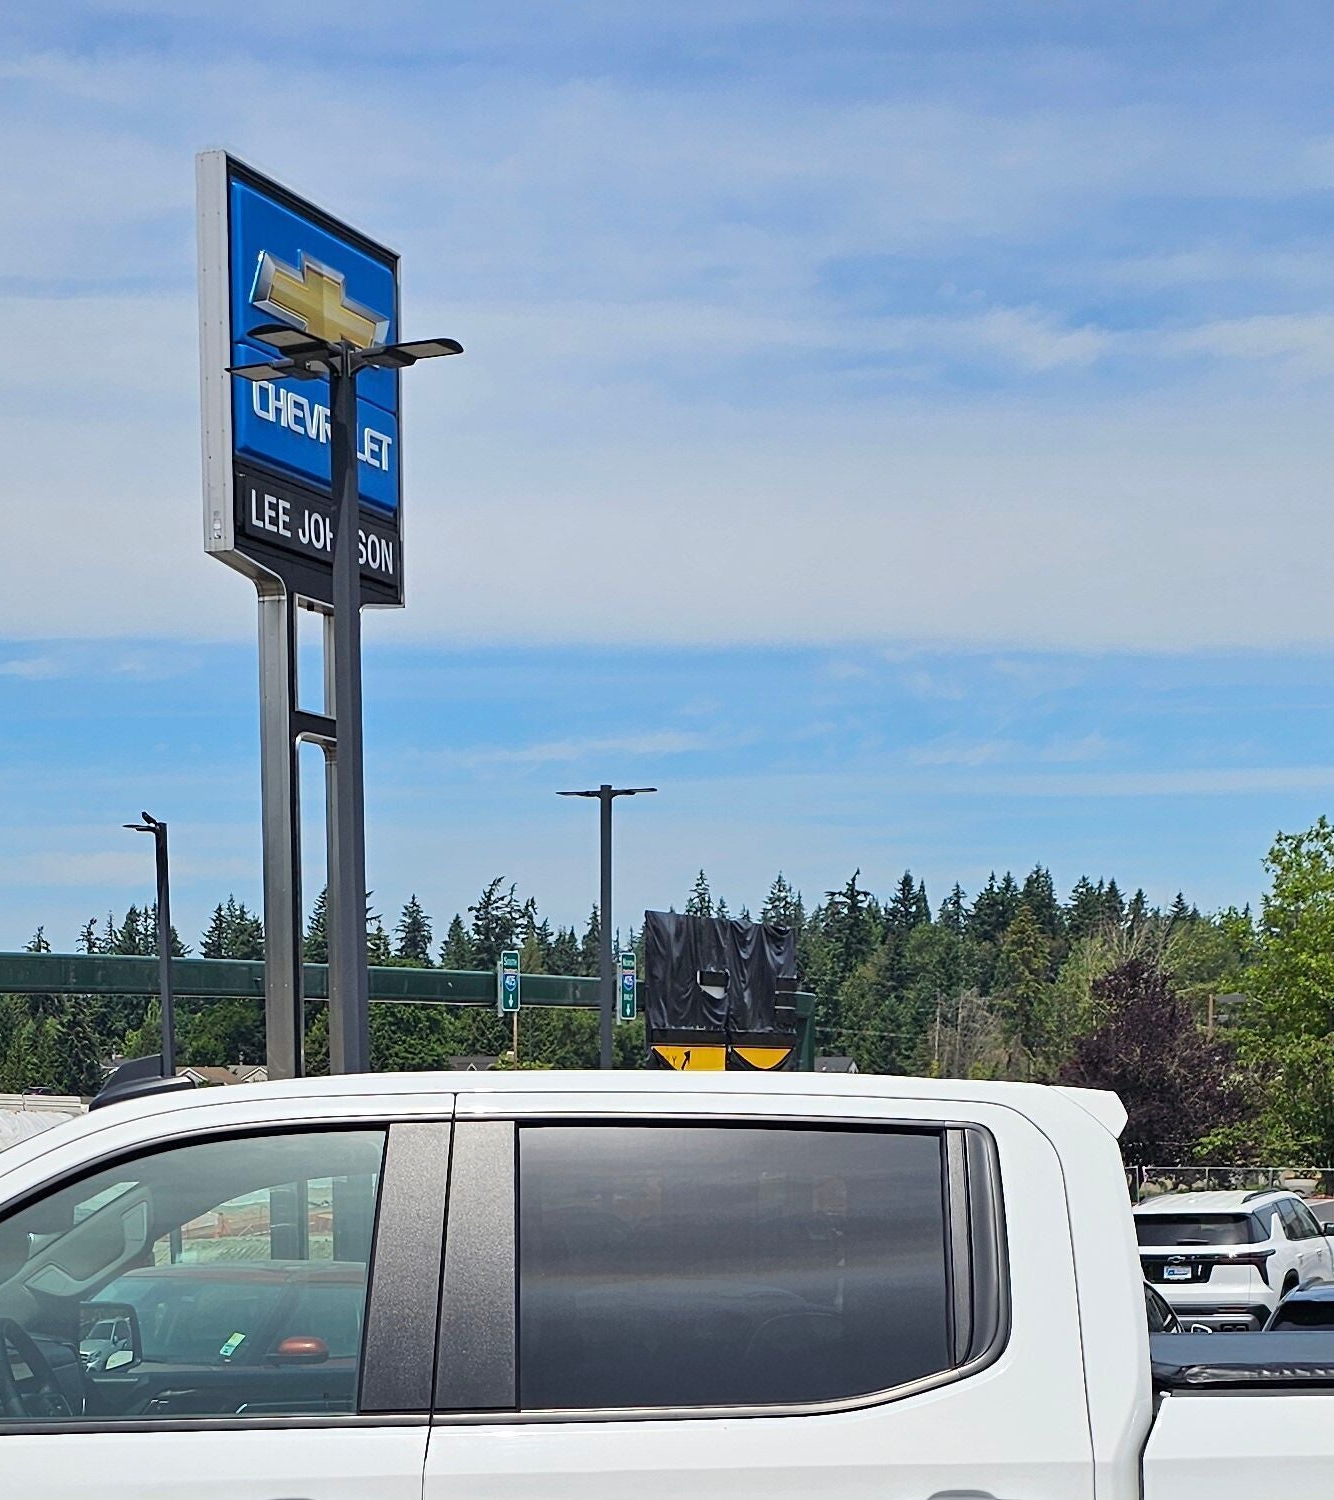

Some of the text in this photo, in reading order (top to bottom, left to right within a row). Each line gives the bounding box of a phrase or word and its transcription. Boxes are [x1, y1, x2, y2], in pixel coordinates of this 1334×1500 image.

[253, 380, 393, 471] CHEVRLET
[251, 488, 393, 575] LEE JOHSON
